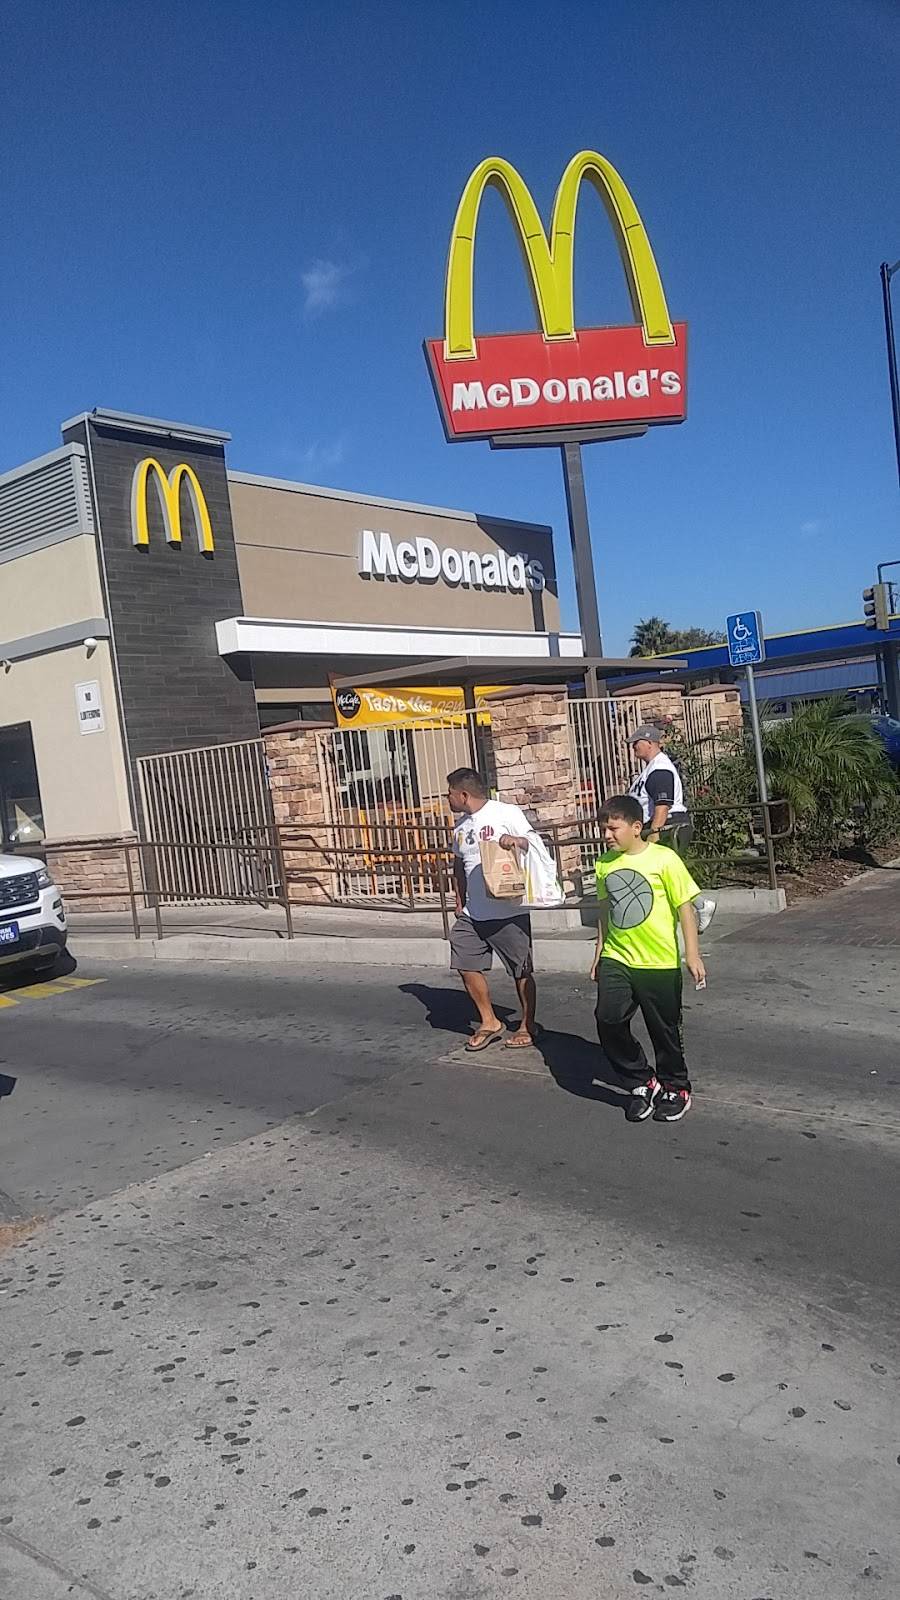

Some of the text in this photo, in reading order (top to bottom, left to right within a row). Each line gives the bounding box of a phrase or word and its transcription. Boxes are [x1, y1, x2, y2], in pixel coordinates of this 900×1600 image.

[451, 368, 683, 412] McDonald's
[360, 529, 546, 594] McDonald's
[362, 692, 407, 712] Taste
[408, 696, 432, 713] the
